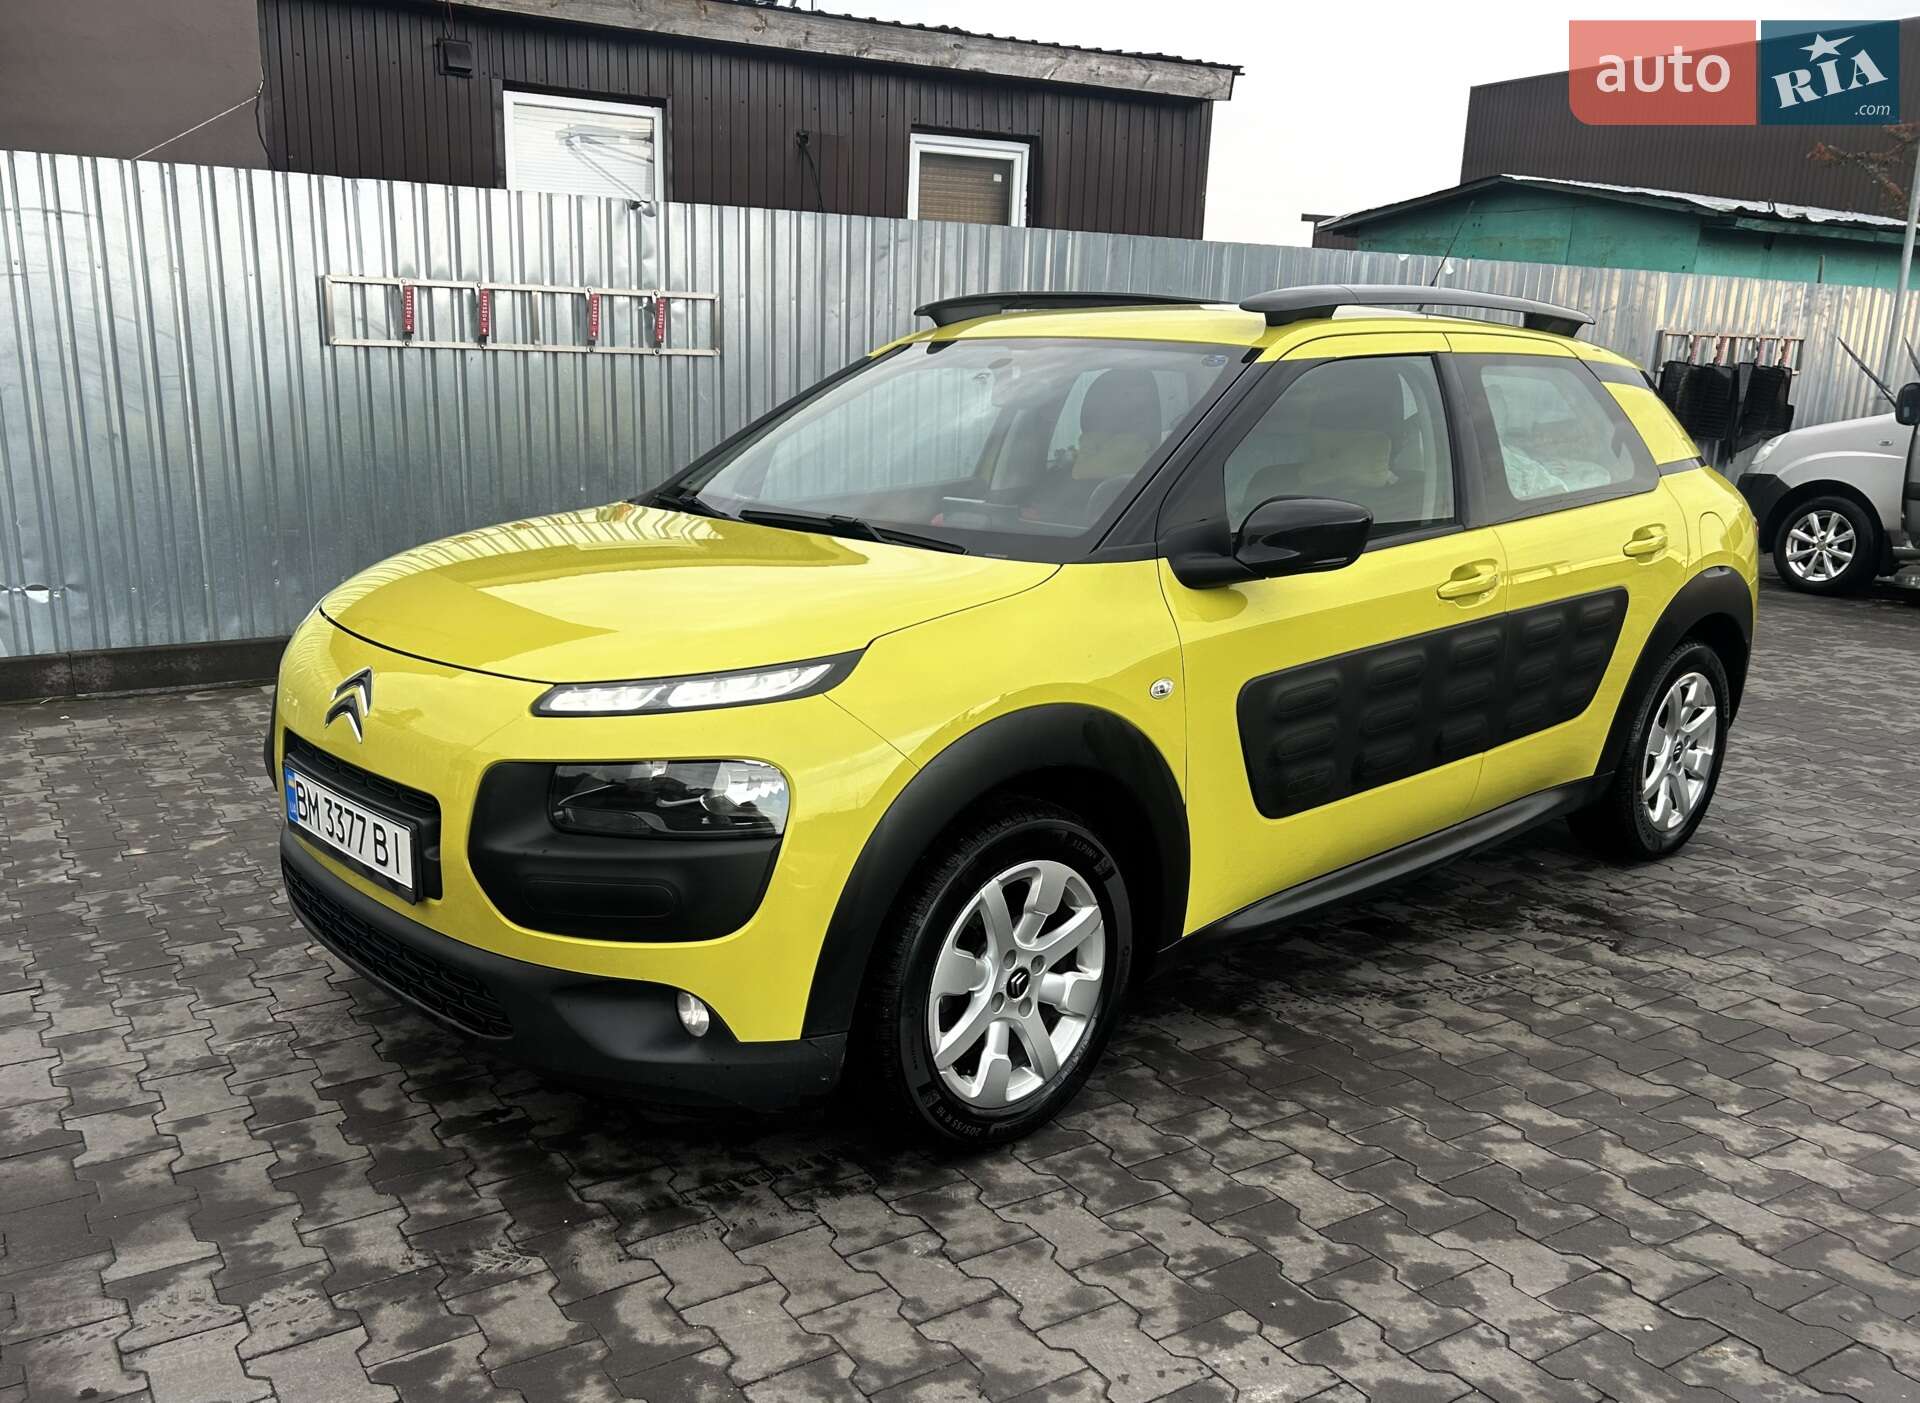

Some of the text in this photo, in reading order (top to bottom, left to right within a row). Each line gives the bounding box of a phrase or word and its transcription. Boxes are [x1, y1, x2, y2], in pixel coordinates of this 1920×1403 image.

[296, 781, 400, 874] BM 3377 BI
